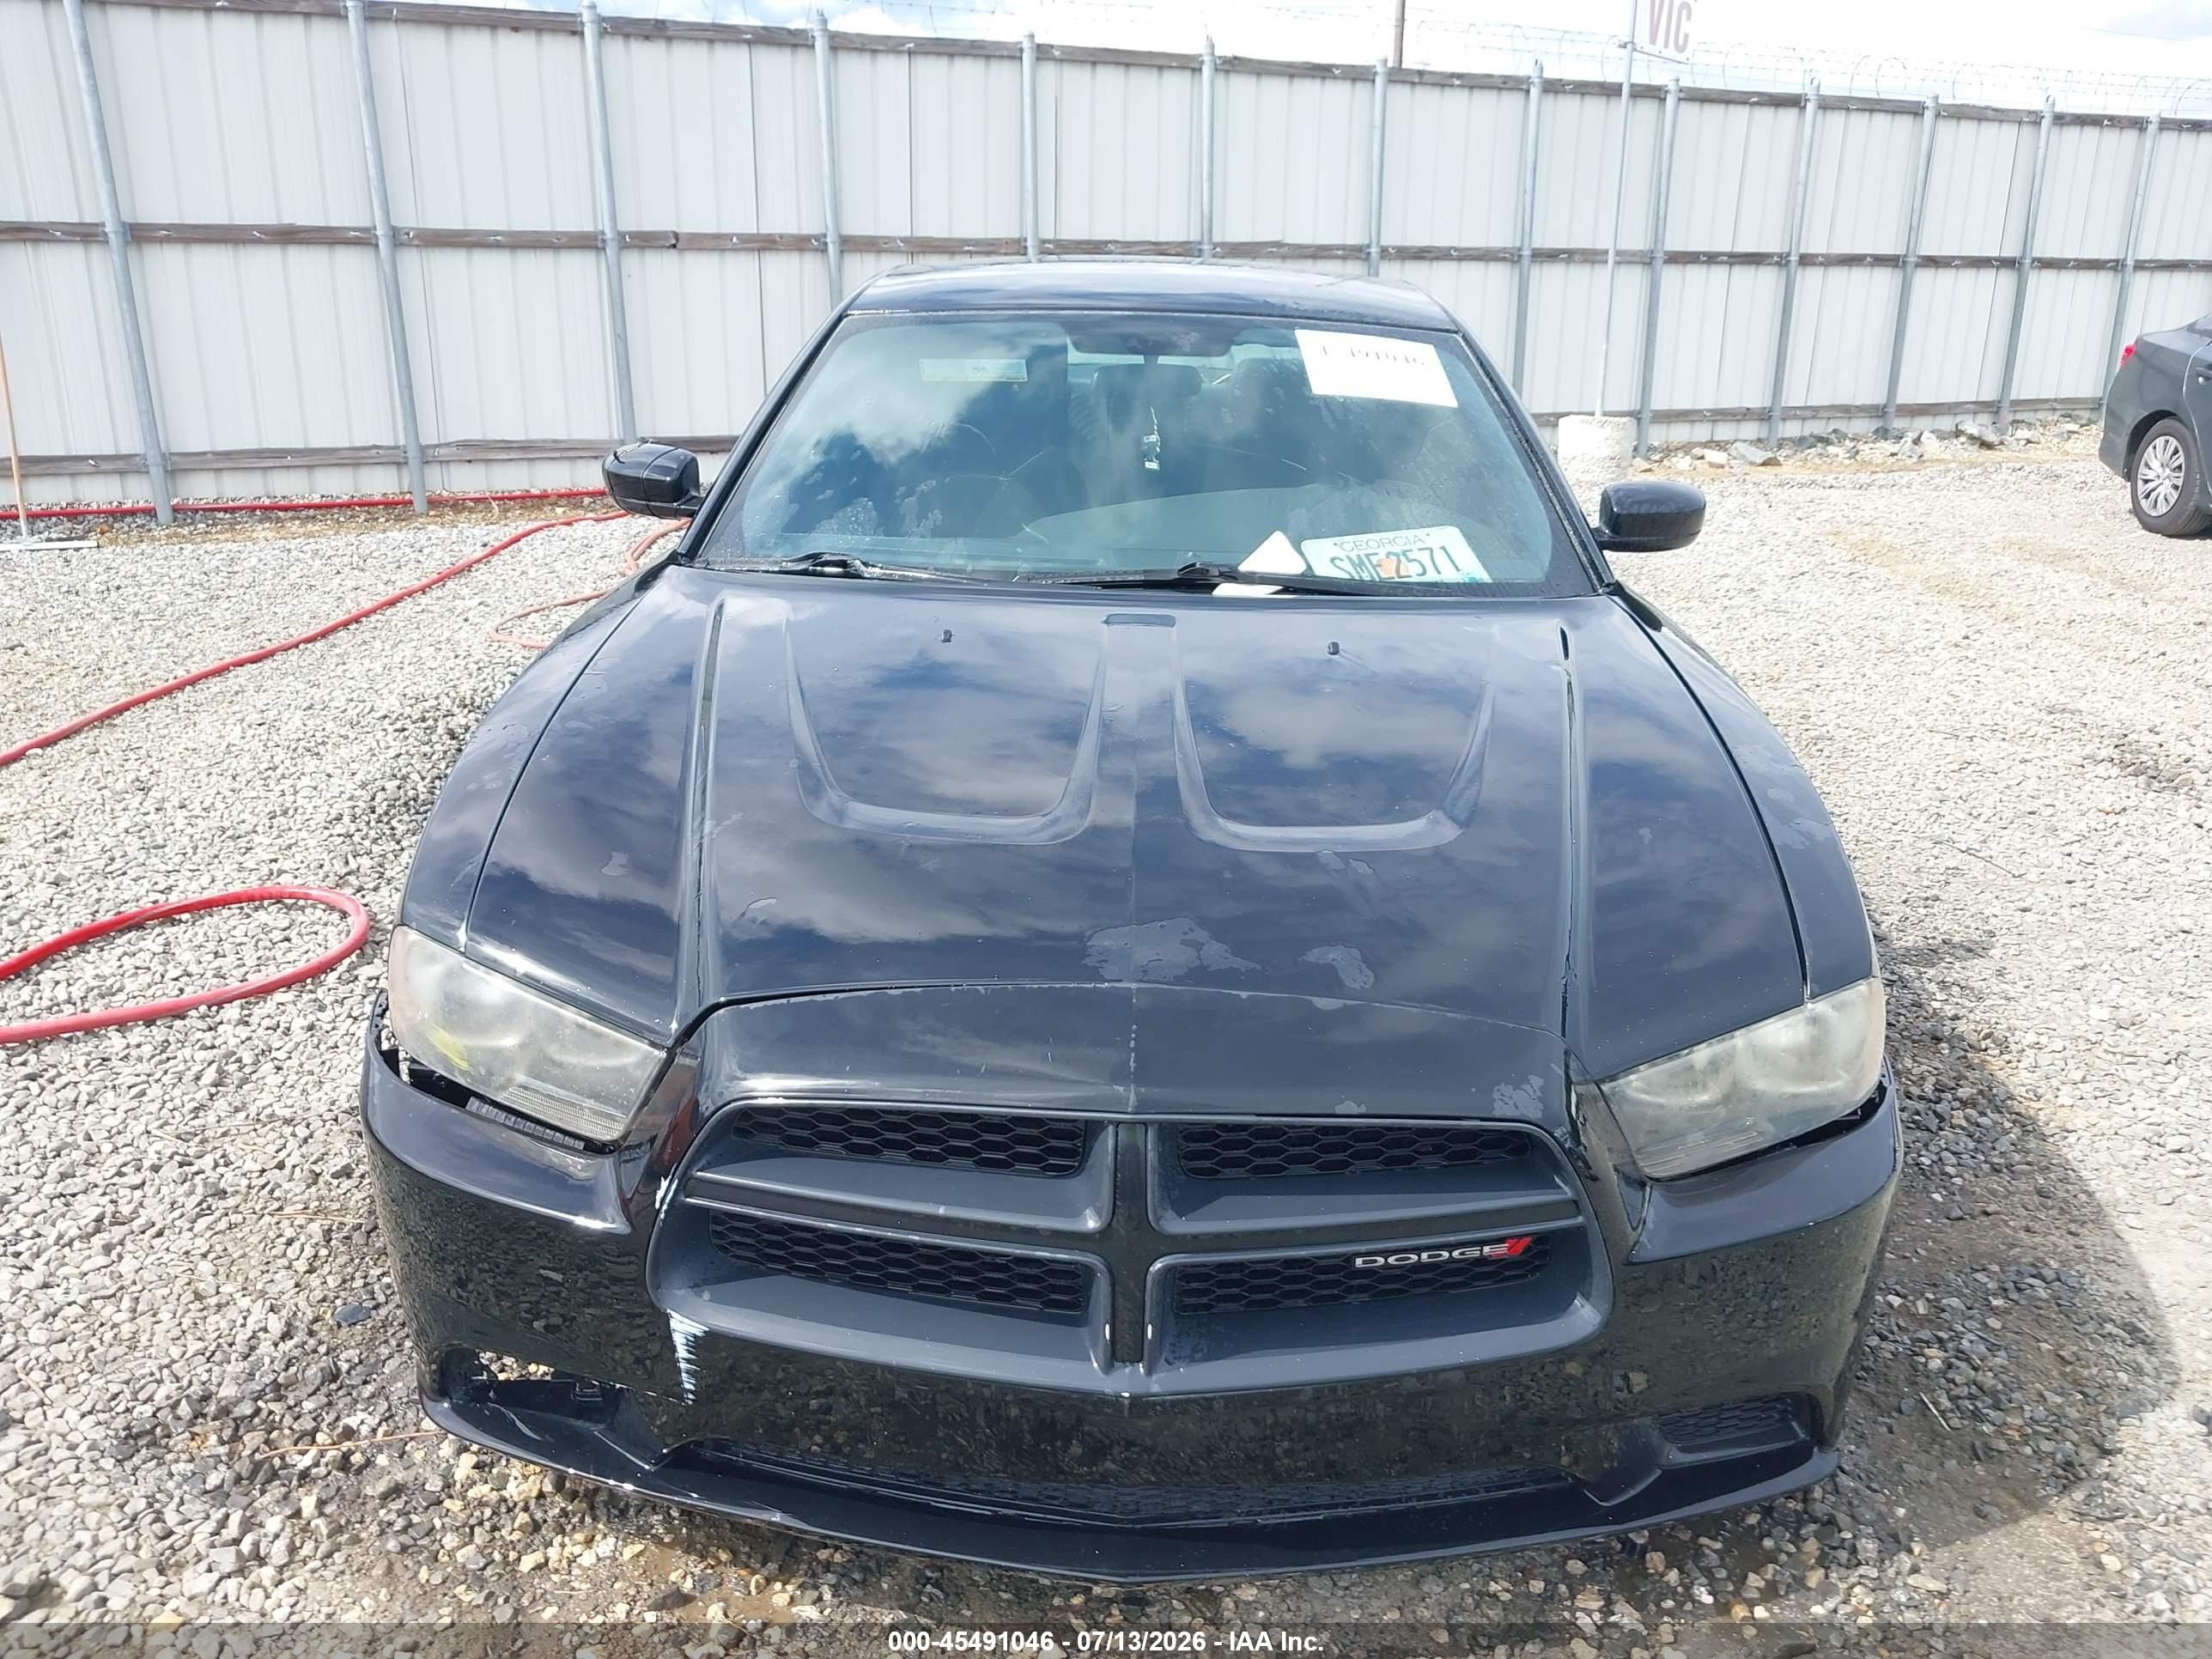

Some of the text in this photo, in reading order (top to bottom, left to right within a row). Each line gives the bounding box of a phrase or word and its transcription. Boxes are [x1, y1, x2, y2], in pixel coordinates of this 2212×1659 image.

[1649, 0, 1692, 53] VIC
[1339, 534, 1426, 552] GEORGIA
[1354, 1243, 1510, 1268] DODGE
